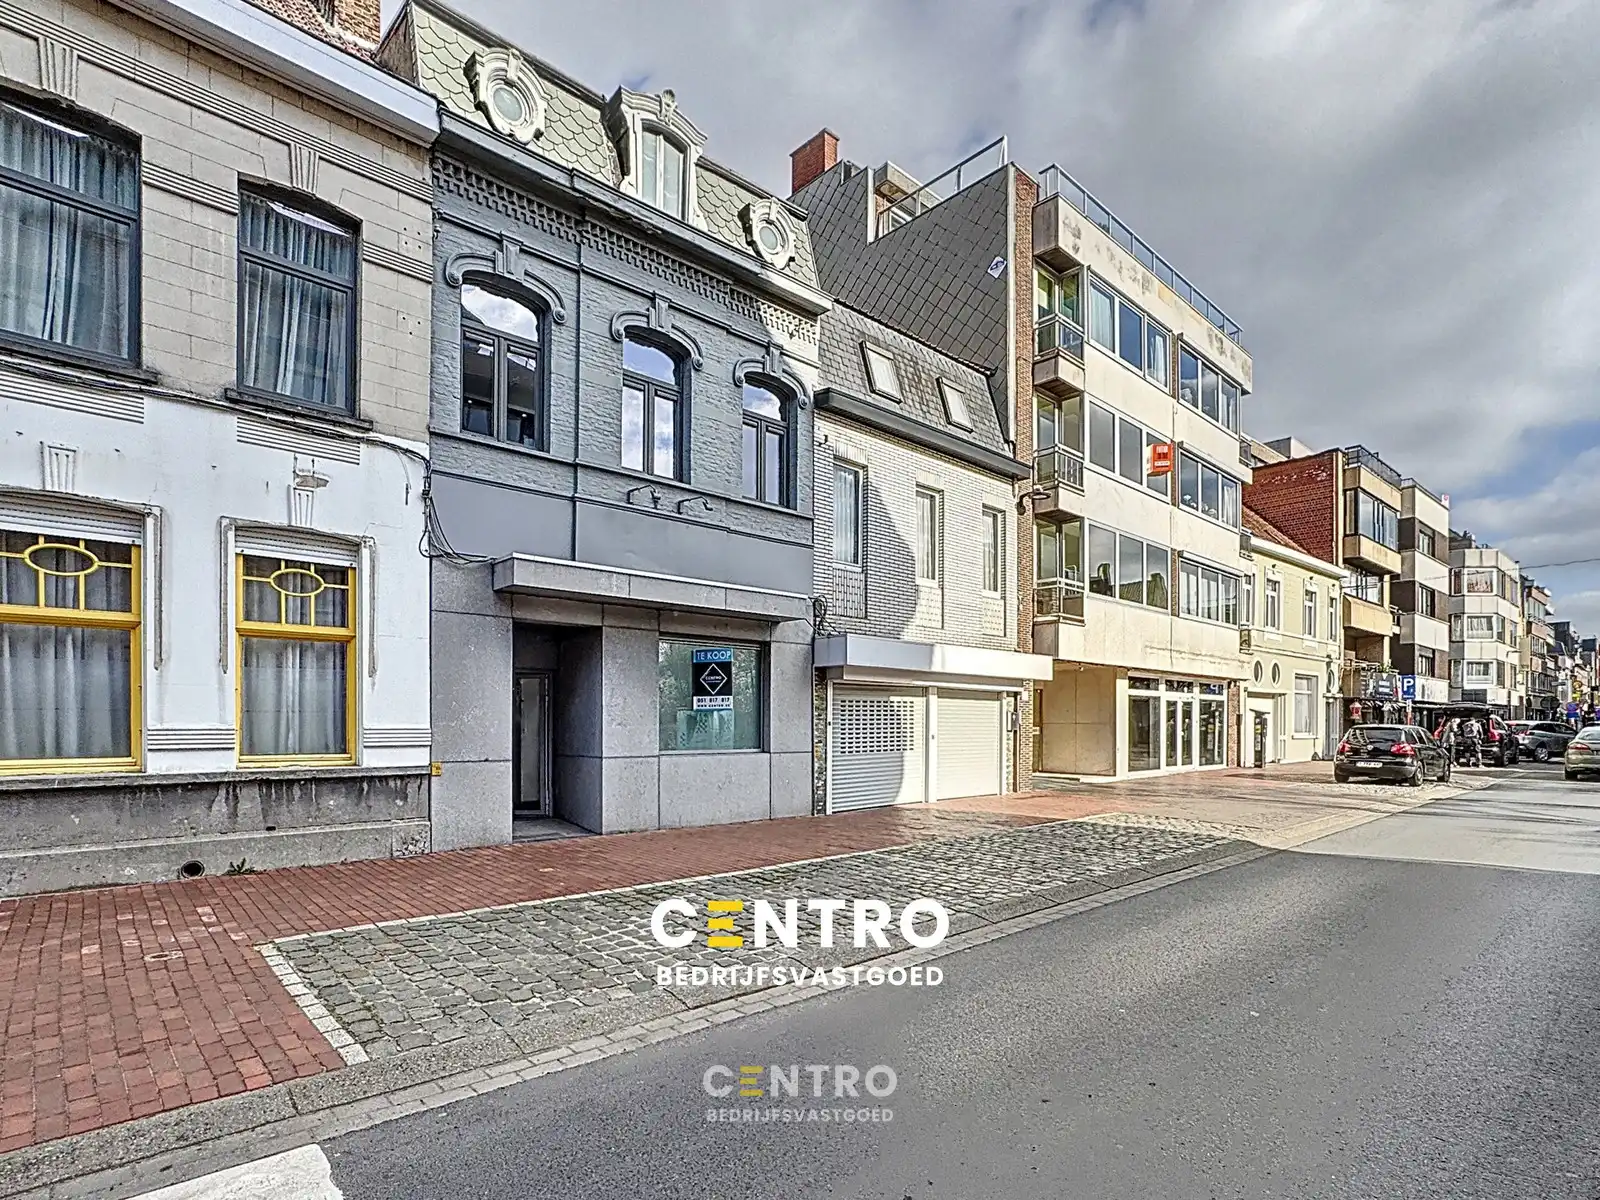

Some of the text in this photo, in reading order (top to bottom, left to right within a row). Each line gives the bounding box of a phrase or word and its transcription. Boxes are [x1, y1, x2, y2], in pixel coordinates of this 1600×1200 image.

[697, 651, 731, 660] TE KOOP
[1403, 678, 1414, 691] P
